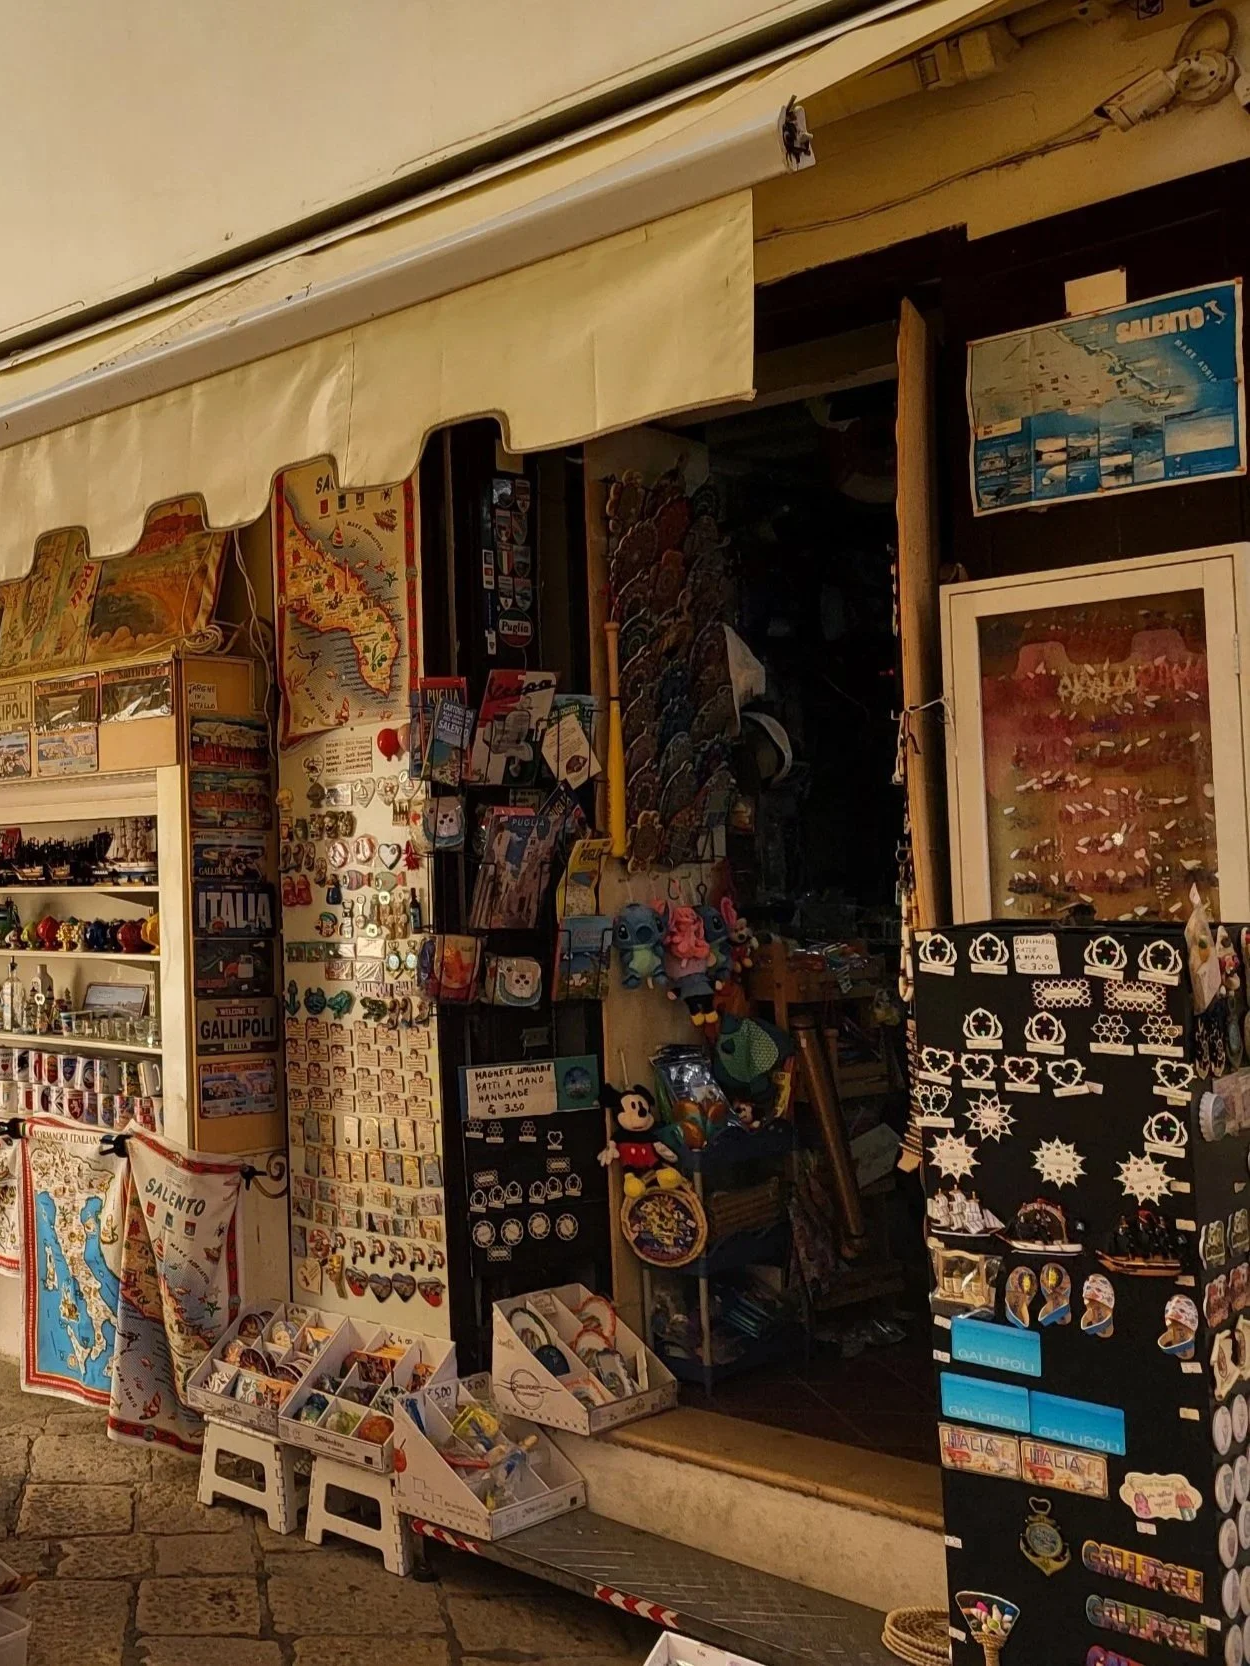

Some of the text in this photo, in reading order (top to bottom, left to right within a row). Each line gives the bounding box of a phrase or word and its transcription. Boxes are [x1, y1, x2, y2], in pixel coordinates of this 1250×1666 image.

[1114, 306, 1205, 344] SALENTO
[500, 620, 529, 634] Puglia
[512, 818, 545, 827] PUGLIA
[198, 891, 273, 929] ITALIA
[200, 1017, 275, 1040] GALLIPOLI
[227, 1042, 248, 1050] ITALIA
[518, 1075, 544, 1087] MANO
[504, 1102, 525, 1114] 3.50
[145, 1177, 206, 1217] SALENTO
[957, 1348, 1036, 1373] GALLIPOLI
[948, 1404, 1026, 1430] GALLIPOLI
[1038, 1426, 1123, 1453] GALLIPOLI
[1029, 1446, 1081, 1473] ITALIA
